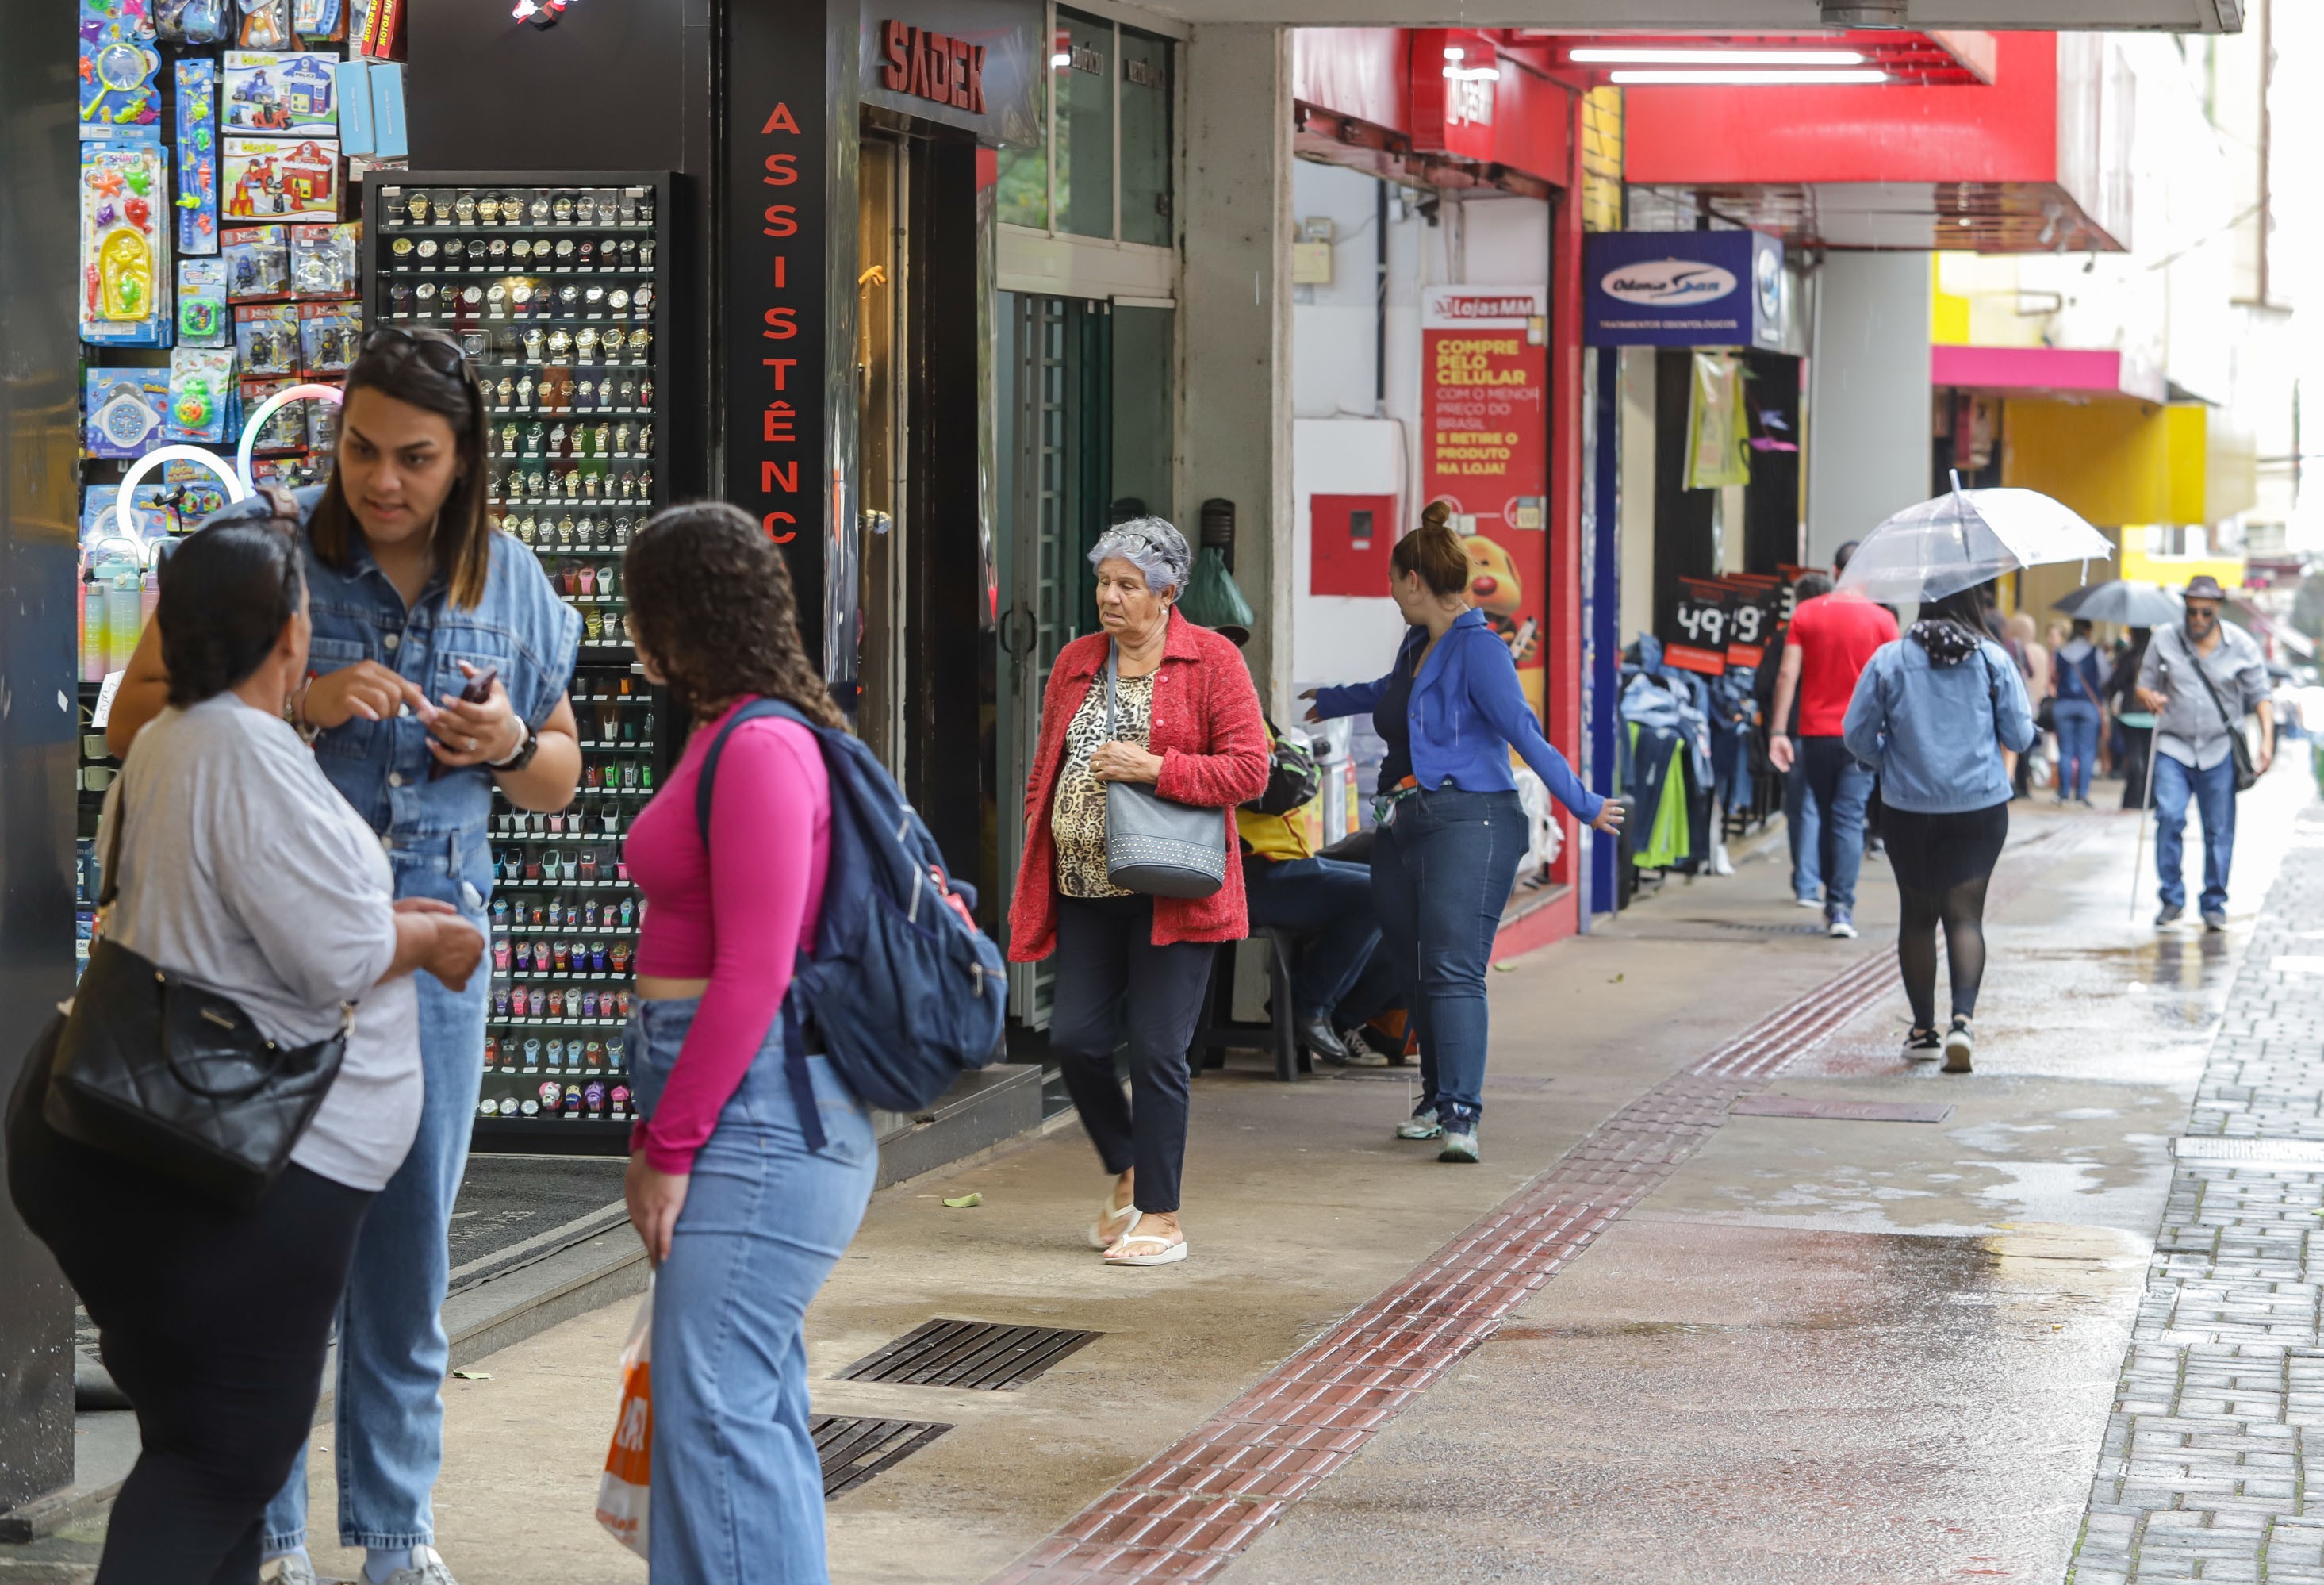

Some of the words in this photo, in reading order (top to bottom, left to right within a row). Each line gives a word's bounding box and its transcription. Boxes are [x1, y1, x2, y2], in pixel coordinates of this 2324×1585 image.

[363, 11, 375, 42] MOTOR
[379, 15, 391, 46] MOTOR
[241, 53, 278, 66] blocks
[882, 18, 988, 114] SADEK
[241, 140, 278, 153] blocks
[1436, 340, 1519, 355] COMPRE
[1436, 355, 1488, 370] PELO
[1436, 370, 1526, 385] CELULAR
[1436, 387, 1470, 400] COM
[1472, 387, 1486, 400] O
[1487, 387, 1540, 400] MENOR
[1488, 402, 1511, 415] DO
[1436, 417, 1485, 430] BRASIL
[1436, 432, 1447, 444] E
[1449, 432, 1502, 444] RETIRE
[1505, 432, 1518, 445] O
[1436, 447, 1510, 460] PRODUTO
[1436, 462, 1459, 474] NA
[1677, 607, 1724, 644] 49
